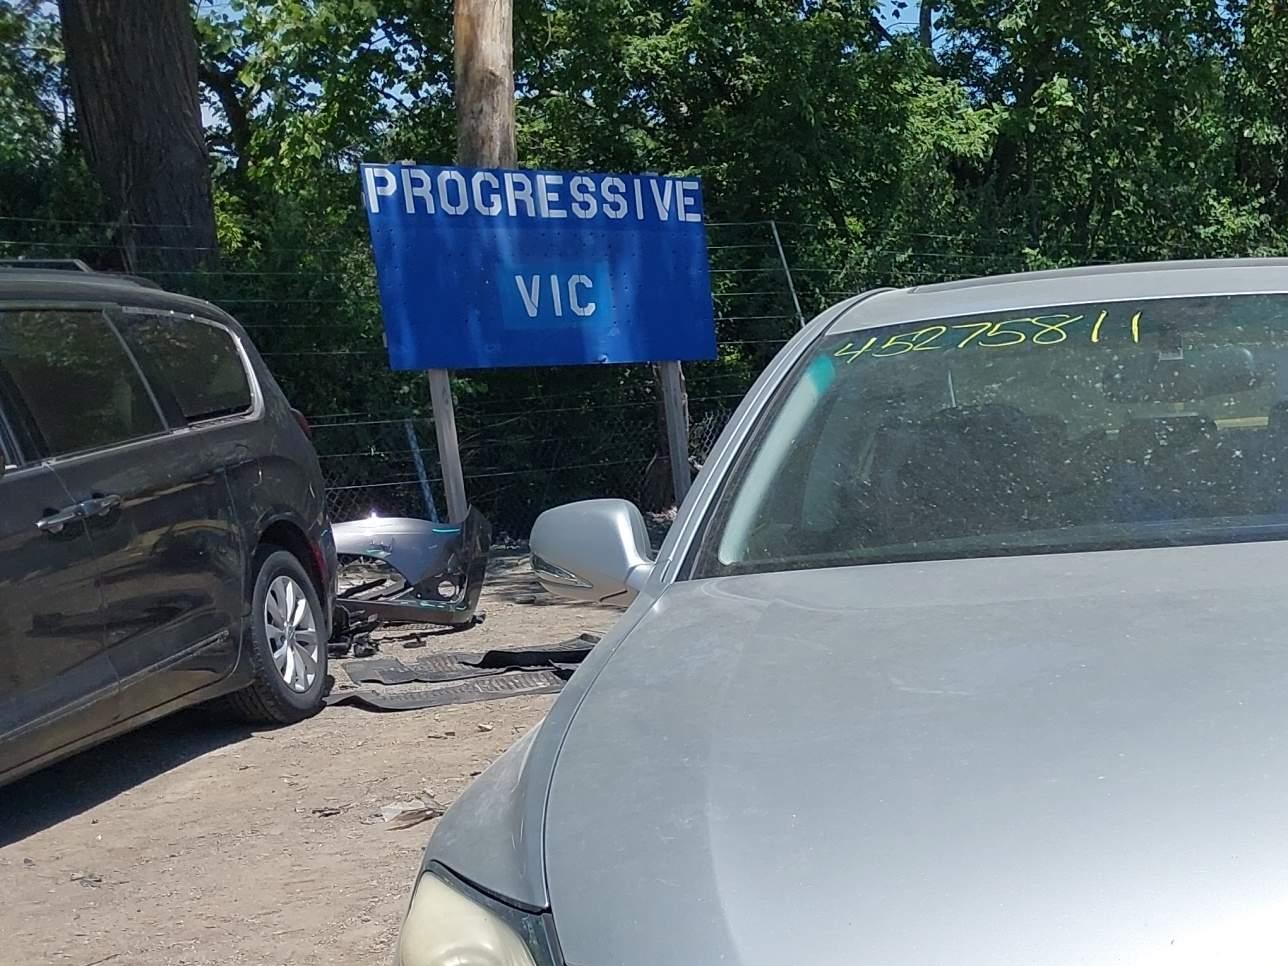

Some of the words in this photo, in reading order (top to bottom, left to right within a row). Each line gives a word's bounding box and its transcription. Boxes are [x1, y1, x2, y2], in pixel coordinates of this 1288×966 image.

[364, 167, 701, 222] PROGRESSIVE
[514, 274, 597, 317] VIC
[833, 309, 1143, 364] 45275811
